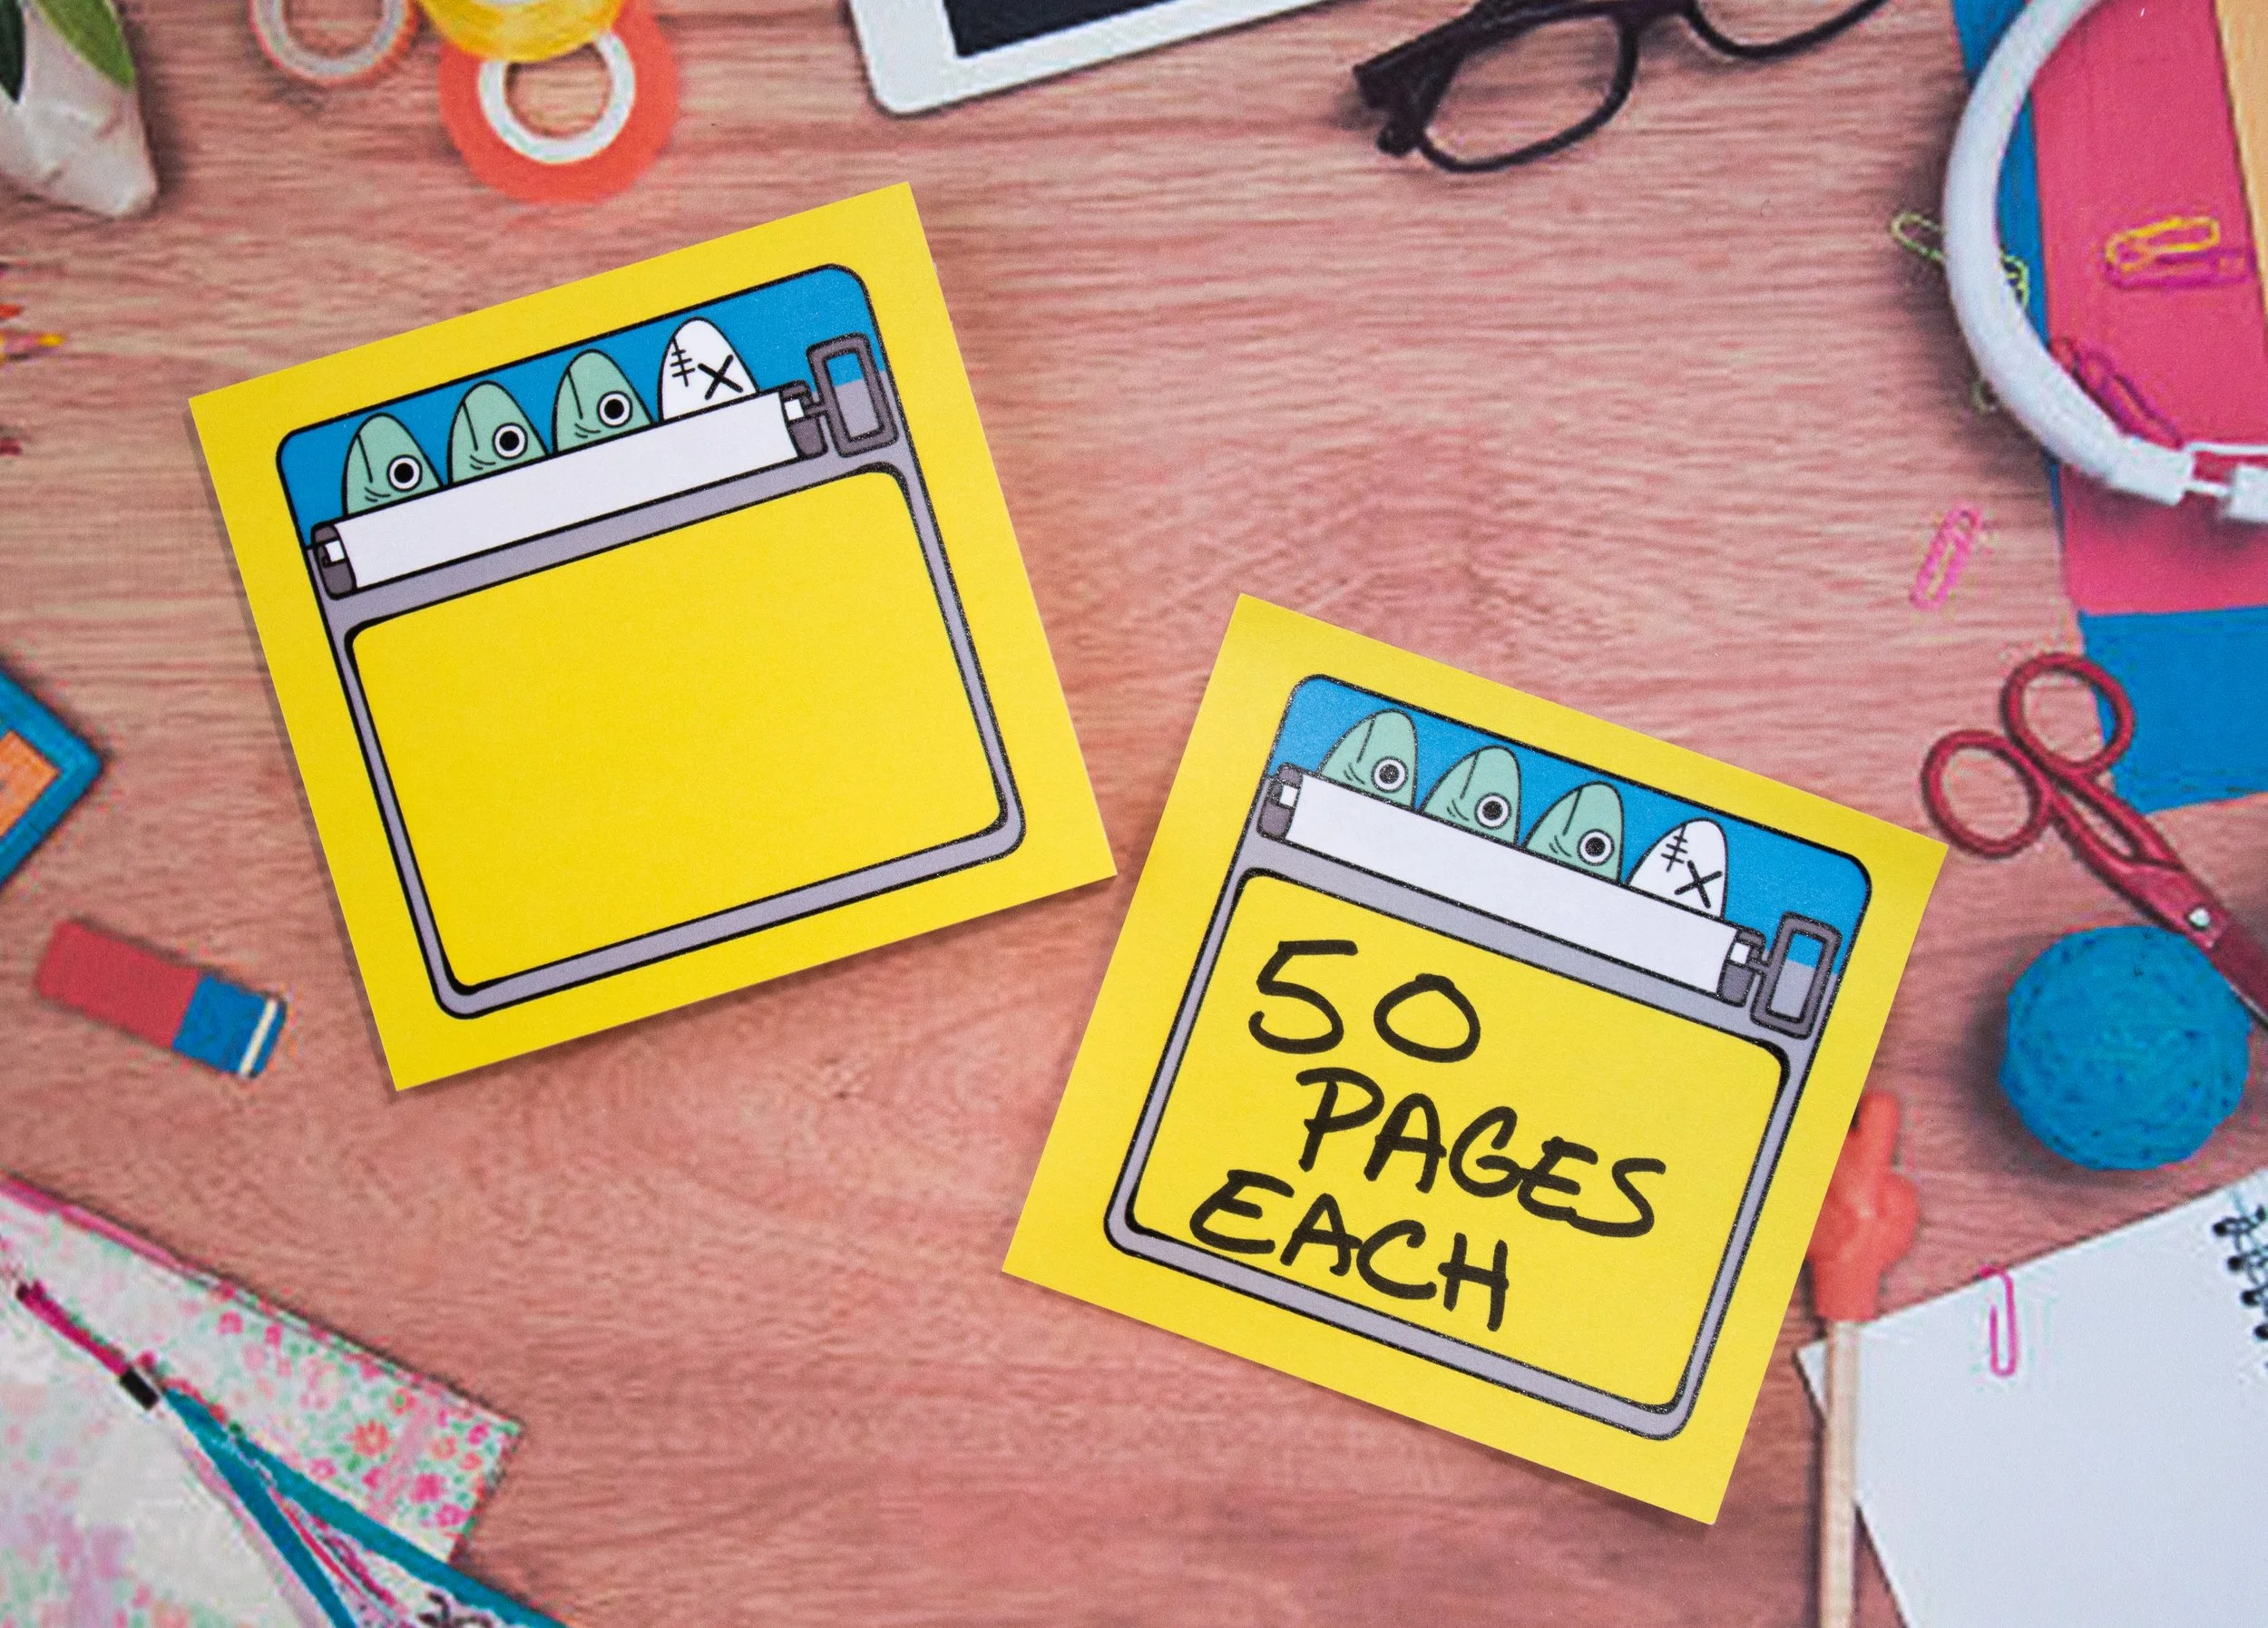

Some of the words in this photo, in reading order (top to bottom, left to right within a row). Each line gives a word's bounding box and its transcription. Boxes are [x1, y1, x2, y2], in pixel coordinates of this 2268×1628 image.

[1248, 939, 1481, 1063] 50
[1295, 1067, 1667, 1238] PAGES
[1189, 1169, 1510, 1332] EACH
